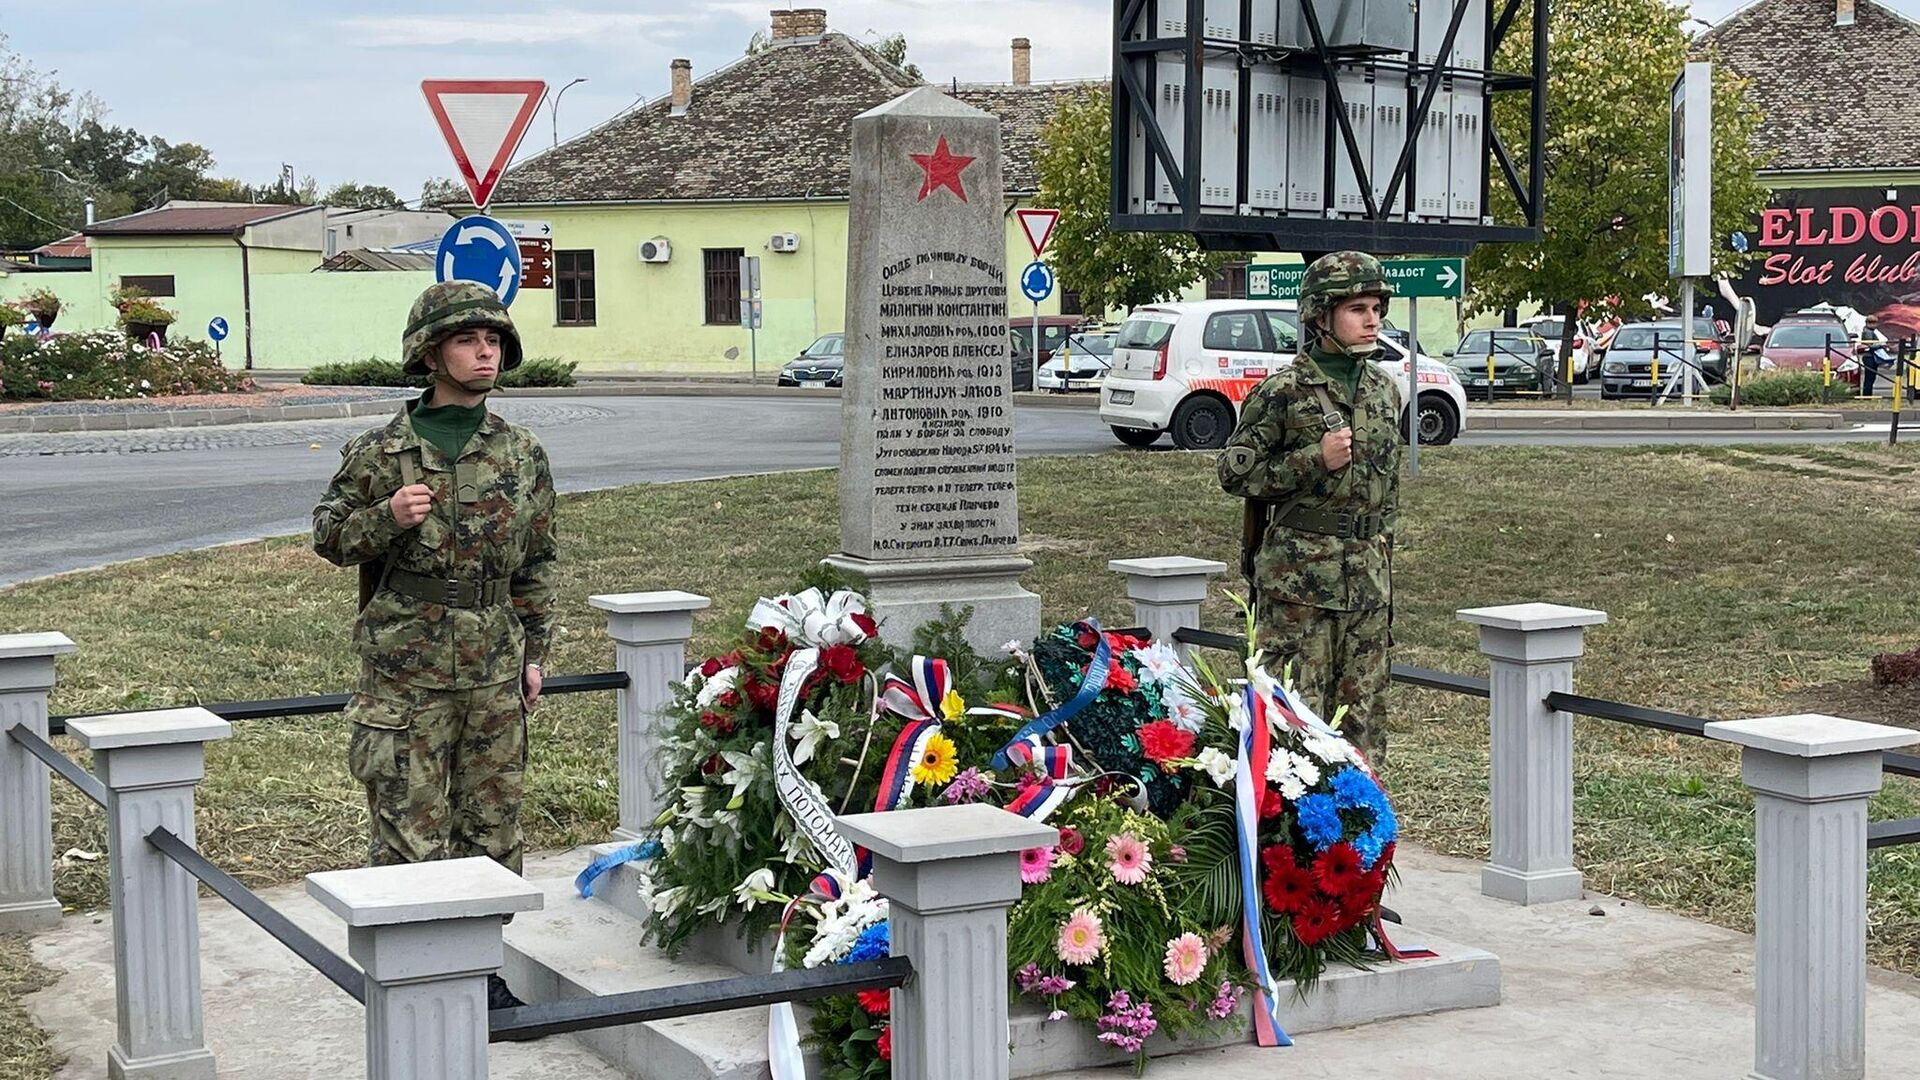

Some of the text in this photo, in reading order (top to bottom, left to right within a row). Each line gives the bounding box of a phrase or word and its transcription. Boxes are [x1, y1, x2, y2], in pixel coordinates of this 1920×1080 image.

[916, 252, 968, 265] ПОЧИВАЈУ
[1271, 266, 1425, 282] Спорт ладост
[1758, 250, 1919, 285] Slot klub
[965, 286, 1006, 297] ДРУГОВИ
[1271, 284, 1301, 298] Sport
[880, 303, 1006, 317] МАЛИГИН КОНСТАНТИН
[886, 345, 1004, 358] ЕЛИЗАРОВ АЛЕКСЕЈ
[883, 366, 955, 379] КИРИЛОВИЋ
[883, 386, 1002, 400] МАРТИНЈУК ЈАКОВ
[977, 406, 1003, 419] 1910
[876, 427, 1010, 439] ПАЛИ У БОРБИ ЗА СЛОБОДУ
